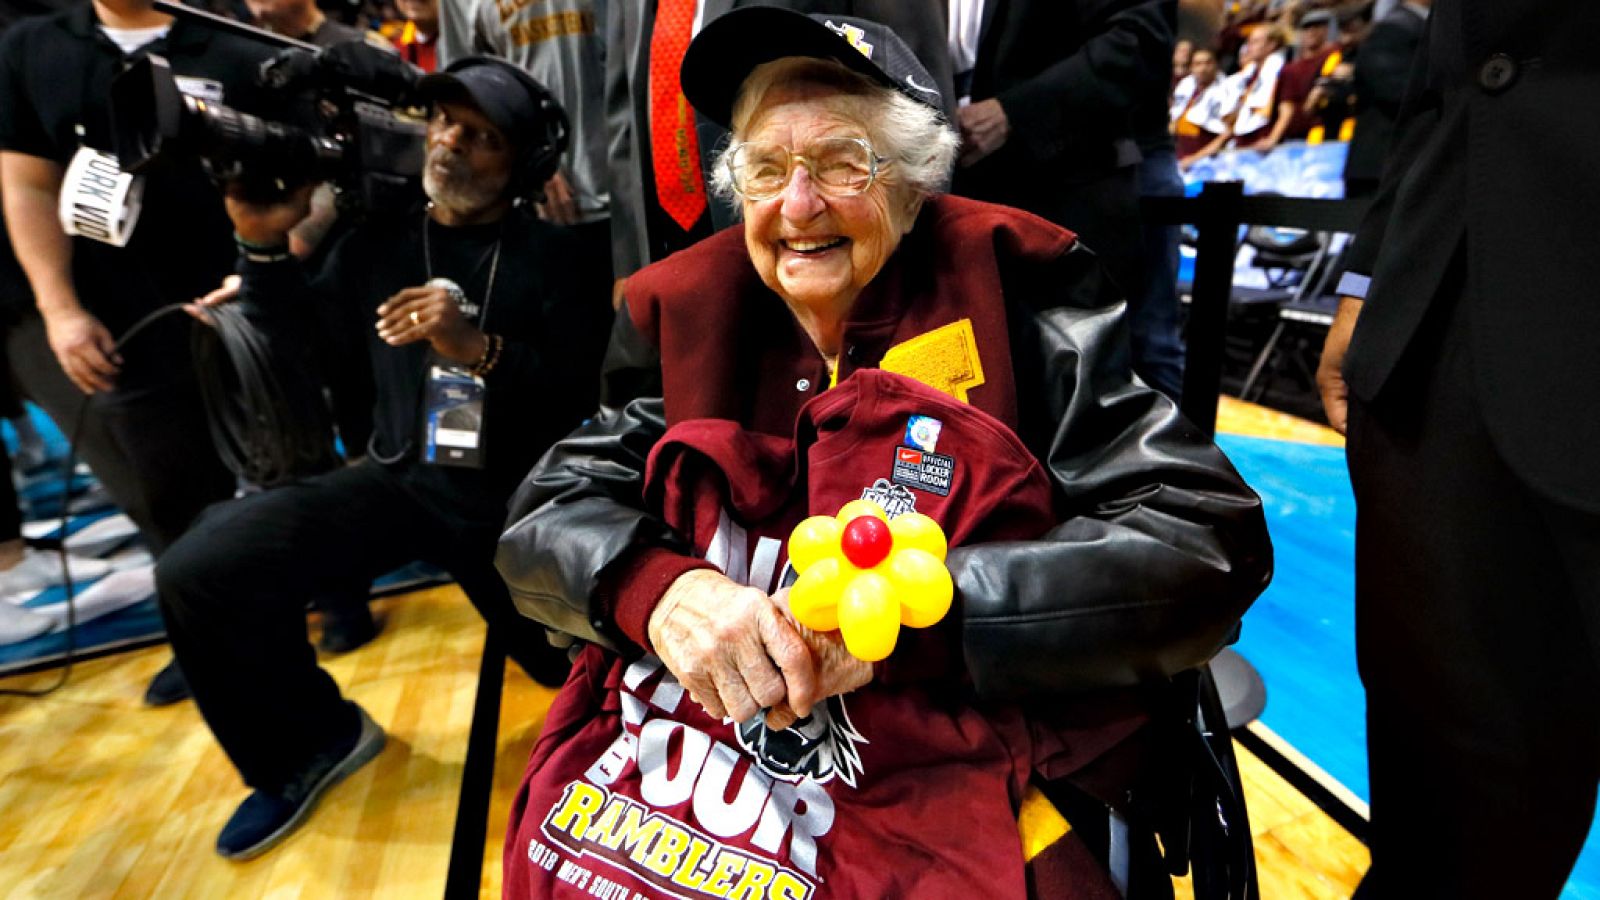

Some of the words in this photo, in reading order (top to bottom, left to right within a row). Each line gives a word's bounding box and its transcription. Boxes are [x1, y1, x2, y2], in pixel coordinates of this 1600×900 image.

[919, 473, 949, 488] ROOM
[920, 463, 950, 478] LOCKER
[543, 781, 814, 900] RAMBLERS
[528, 838, 560, 872] 2018
[556, 858, 593, 890] MEN'S
